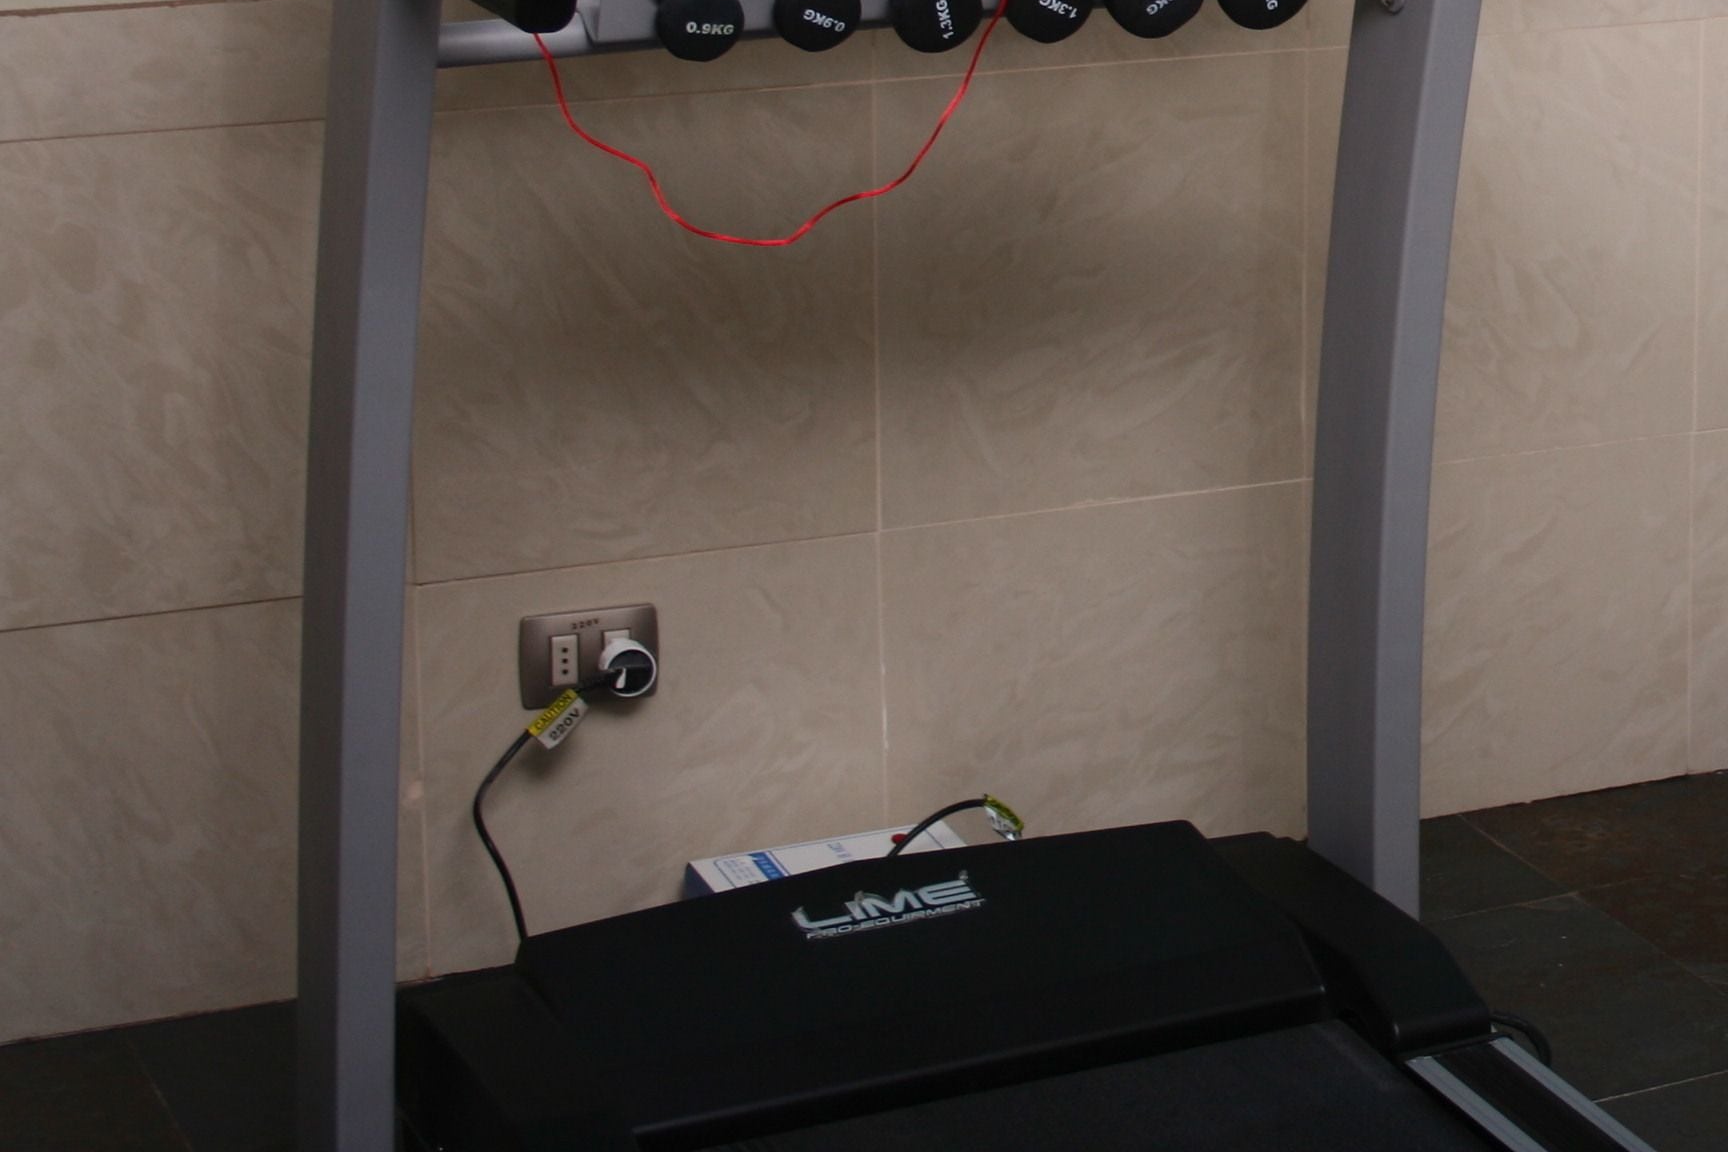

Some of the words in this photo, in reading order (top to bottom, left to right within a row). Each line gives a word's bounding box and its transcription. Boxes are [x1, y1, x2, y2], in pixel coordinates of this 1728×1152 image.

[685, 21, 735, 36] 0.9KG
[802, 8, 846, 33] 0.9KG
[935, 0, 955, 40] 1.3KG
[535, 693, 574, 731] CAUTION
[549, 706, 581, 741] 220V
[791, 879, 978, 930] LIME
